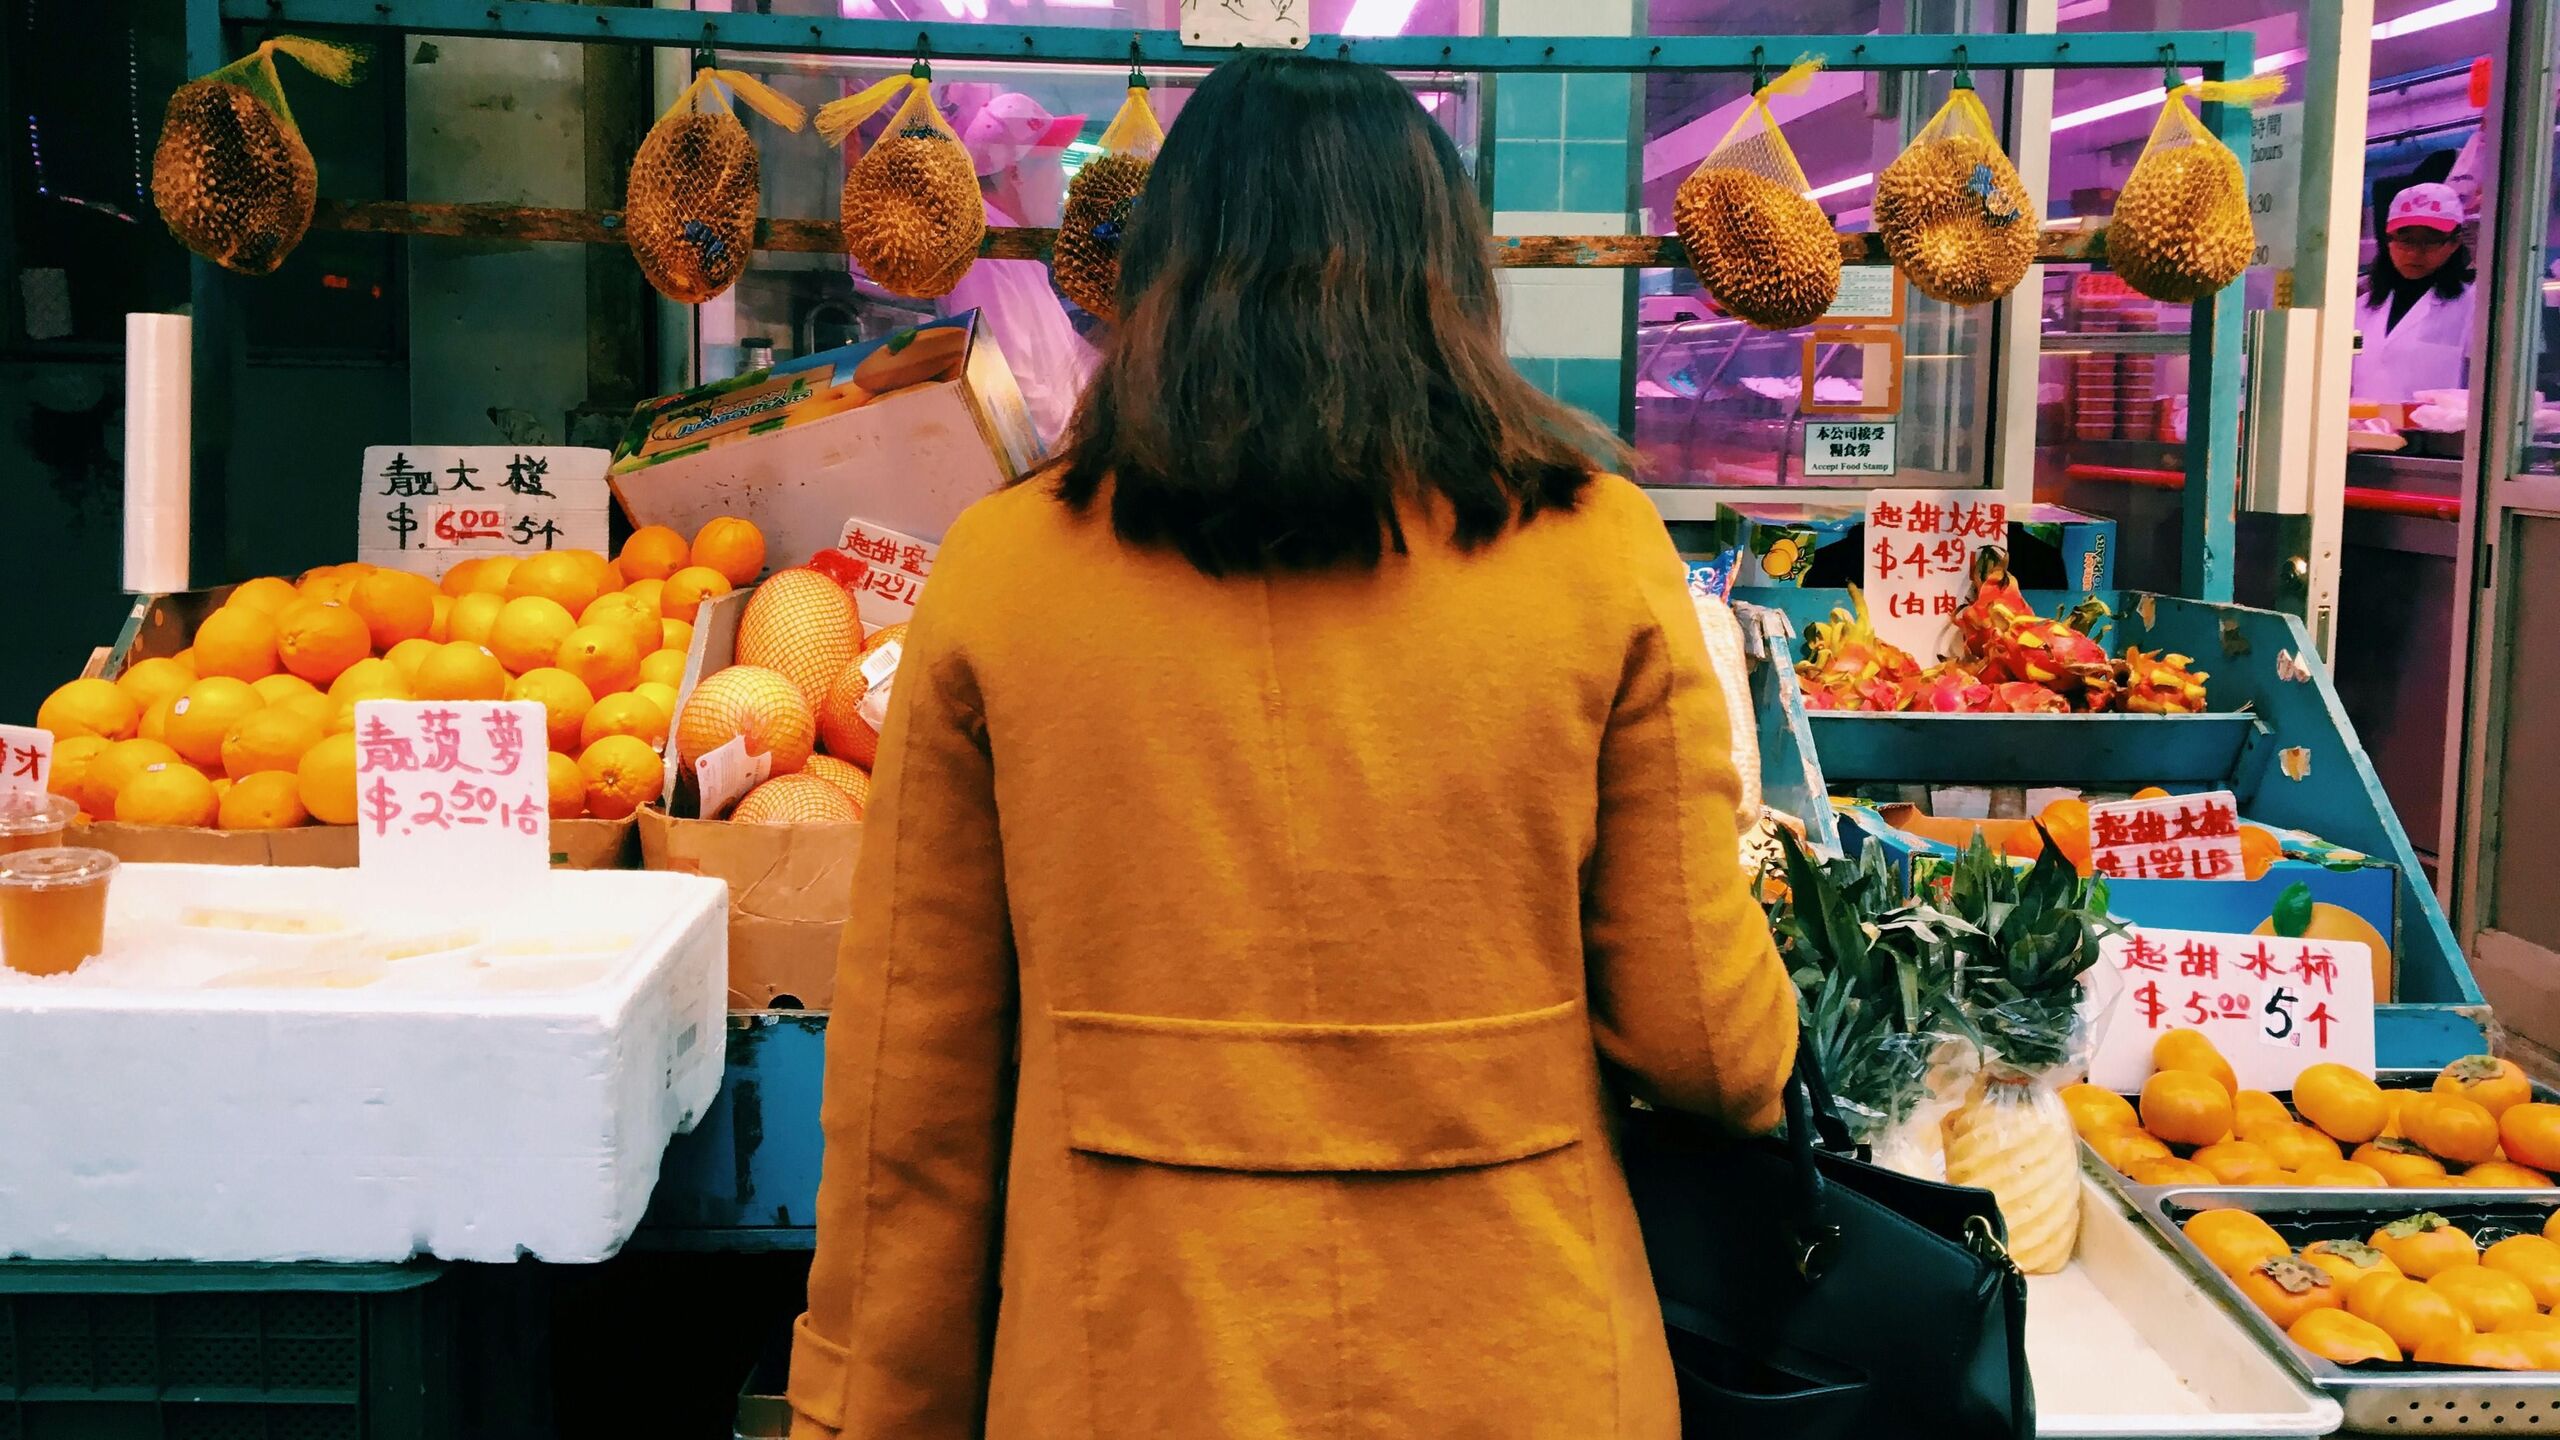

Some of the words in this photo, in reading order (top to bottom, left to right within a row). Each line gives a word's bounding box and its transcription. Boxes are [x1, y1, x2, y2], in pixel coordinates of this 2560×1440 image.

[674, 409, 750, 438] JUMBO
[1817, 426, 1885, 440] 本公司接受
[1811, 463, 1838, 472] Accept
[1863, 463, 1888, 471] Stamp
